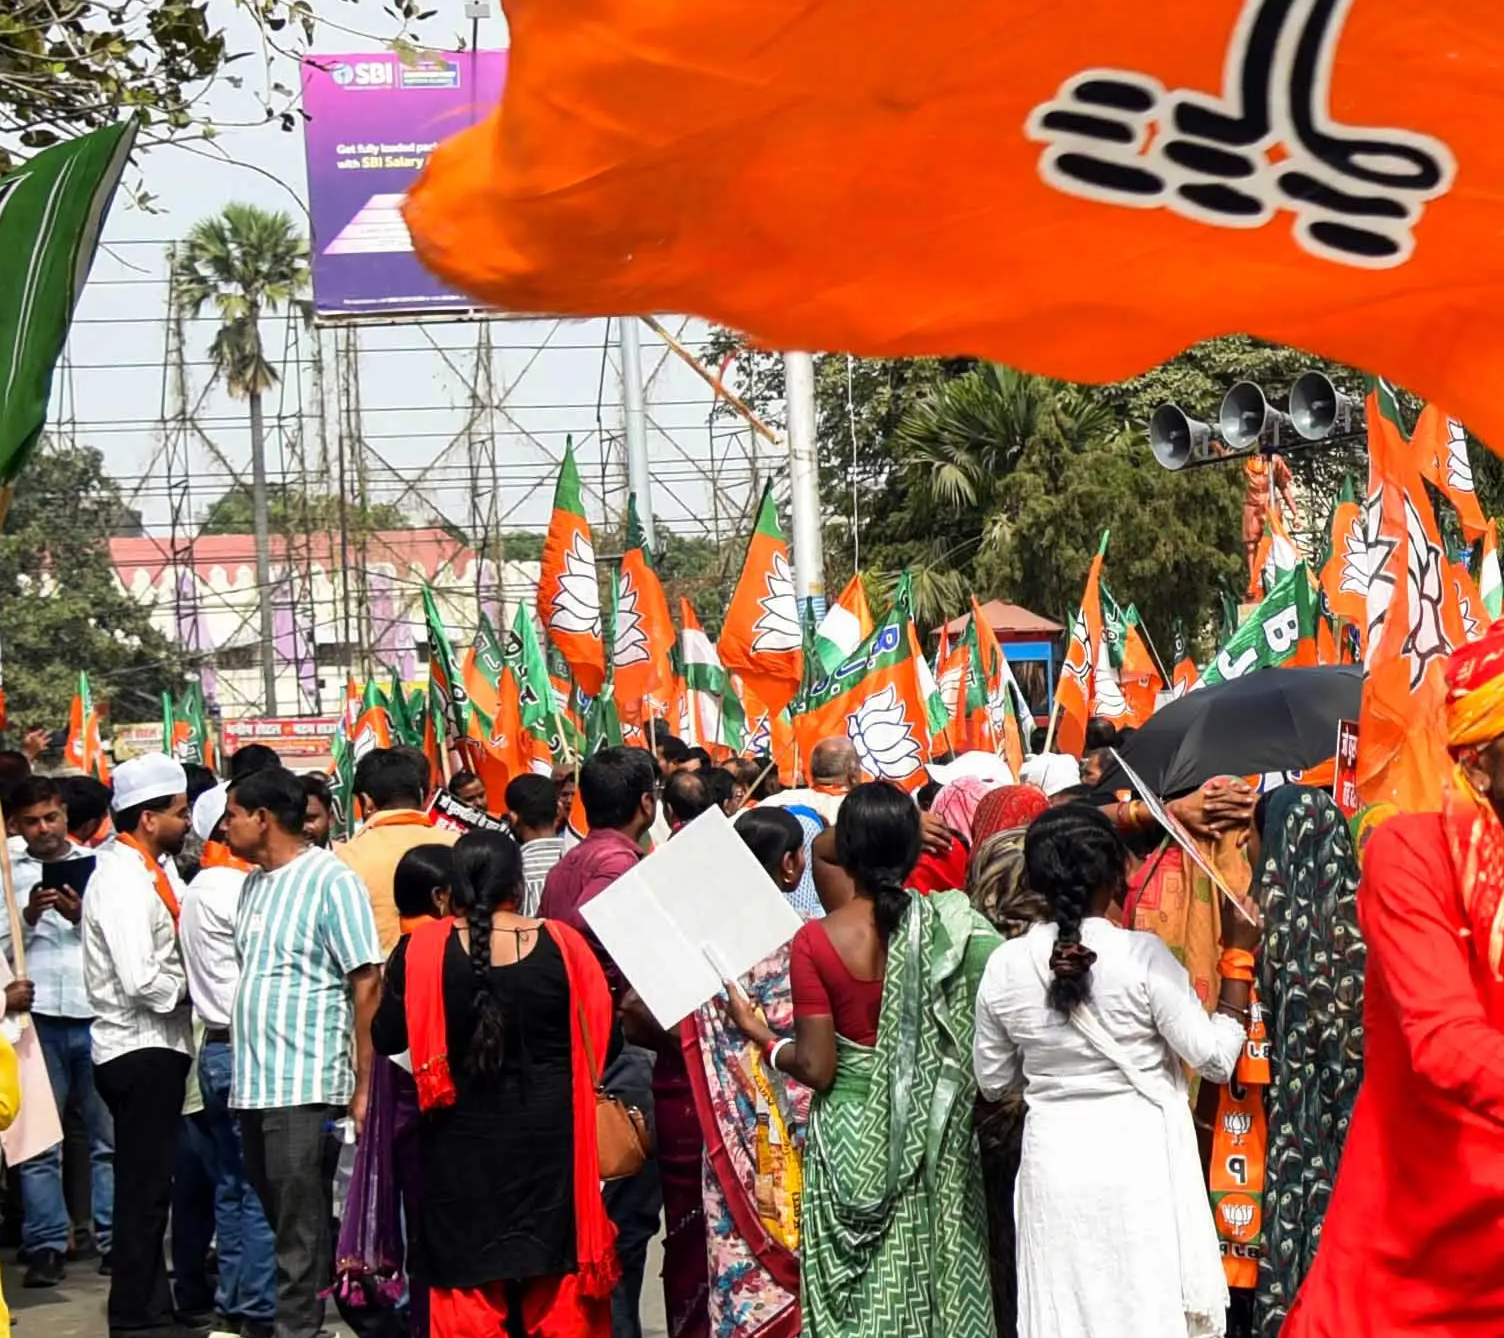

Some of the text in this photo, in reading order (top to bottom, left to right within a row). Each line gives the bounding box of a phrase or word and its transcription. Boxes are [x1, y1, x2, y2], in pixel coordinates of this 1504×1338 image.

[354, 62, 393, 85] SBI
[336, 144, 355, 155] Get
[416, 142, 437, 154] pac
[336, 156, 425, 170] with SBI Salary
[1216, 604, 1300, 681] BJ
